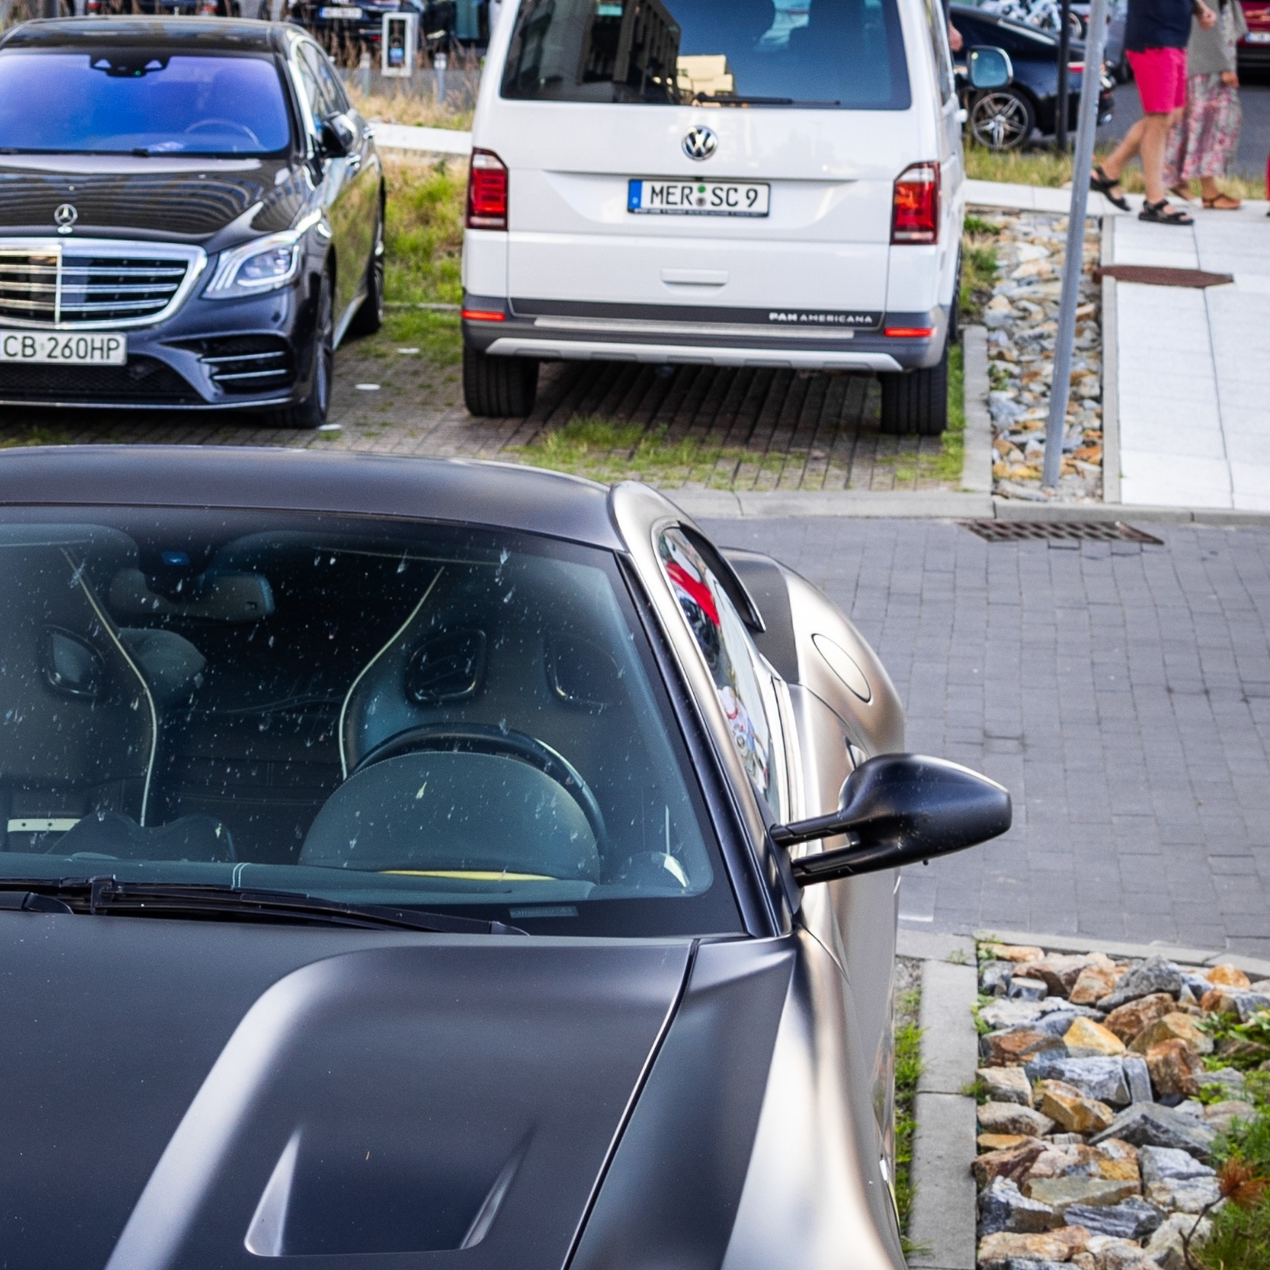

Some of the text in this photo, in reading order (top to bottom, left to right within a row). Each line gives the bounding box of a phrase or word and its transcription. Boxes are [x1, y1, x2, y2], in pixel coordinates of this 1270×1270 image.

[650, 184, 759, 208] MER SC 9
[768, 312, 873, 323] PAN AMERICANA
[3, 335, 120, 360] CB 260HP
